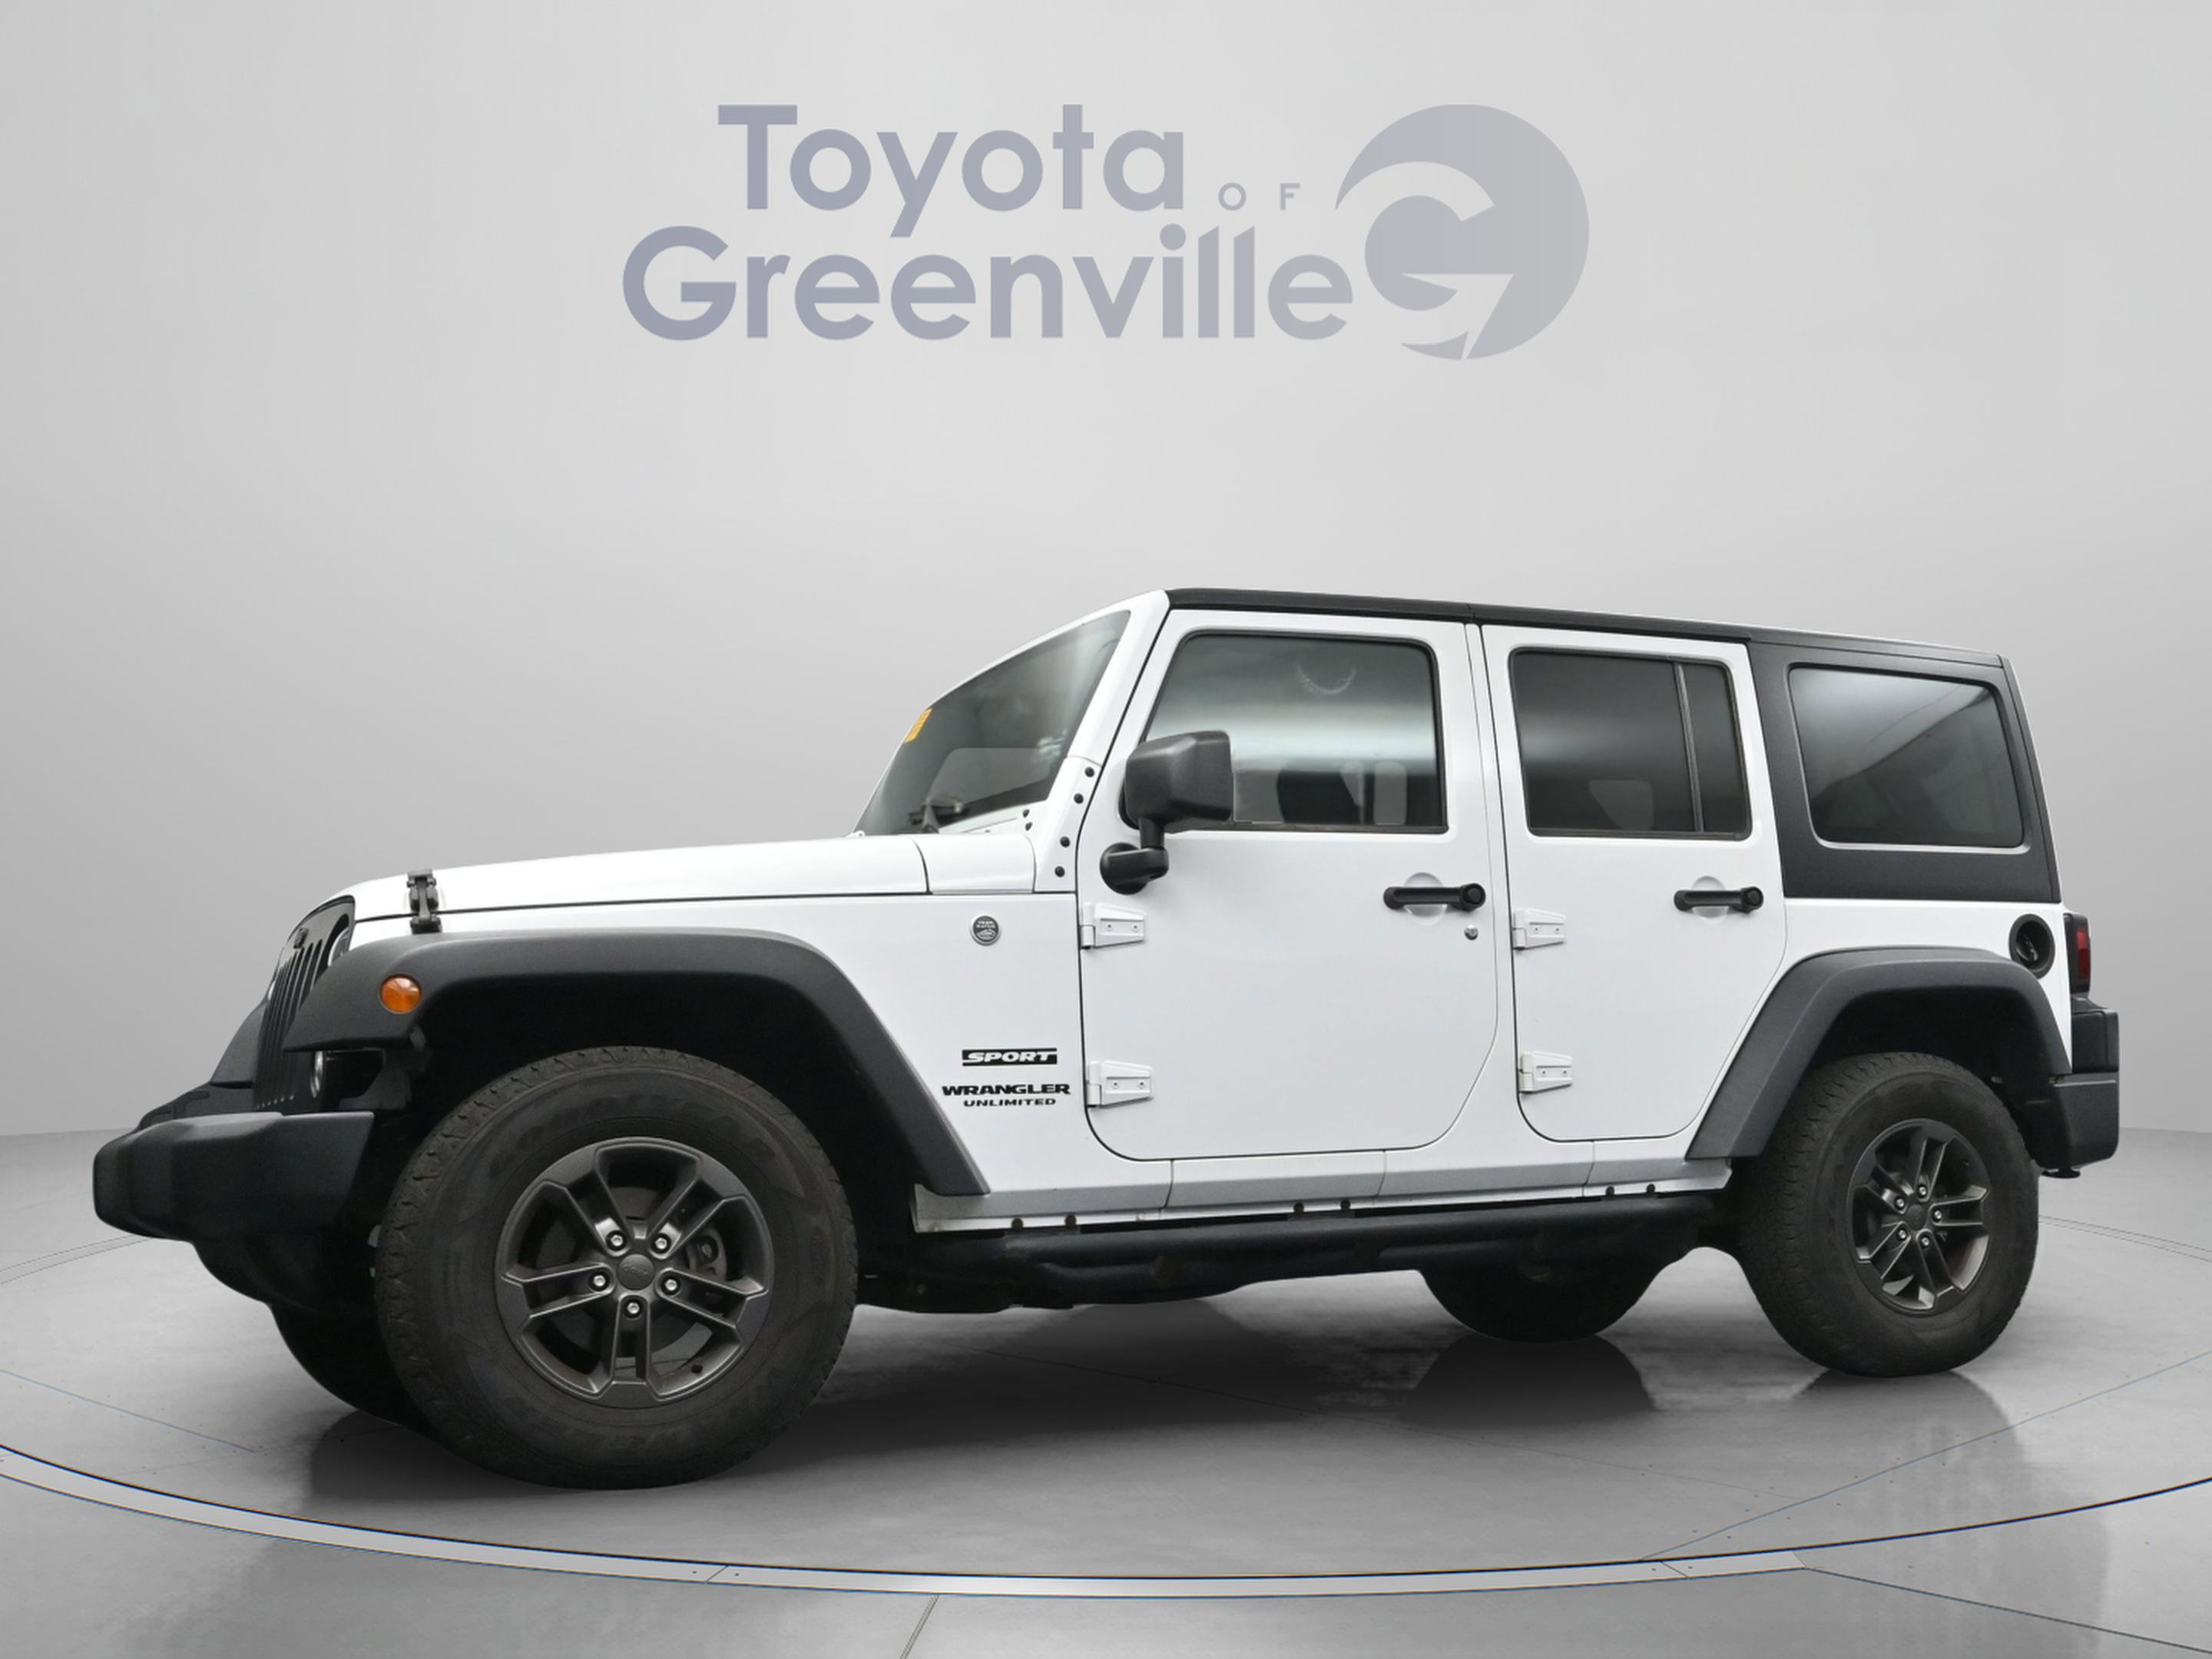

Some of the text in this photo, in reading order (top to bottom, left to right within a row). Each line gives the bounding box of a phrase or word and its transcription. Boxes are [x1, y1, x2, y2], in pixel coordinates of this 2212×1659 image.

[964, 1050, 1057, 1064] SPORT
[942, 1084, 1071, 1096] WRANGLER
[964, 1098, 1056, 1108] UNLIMITED
